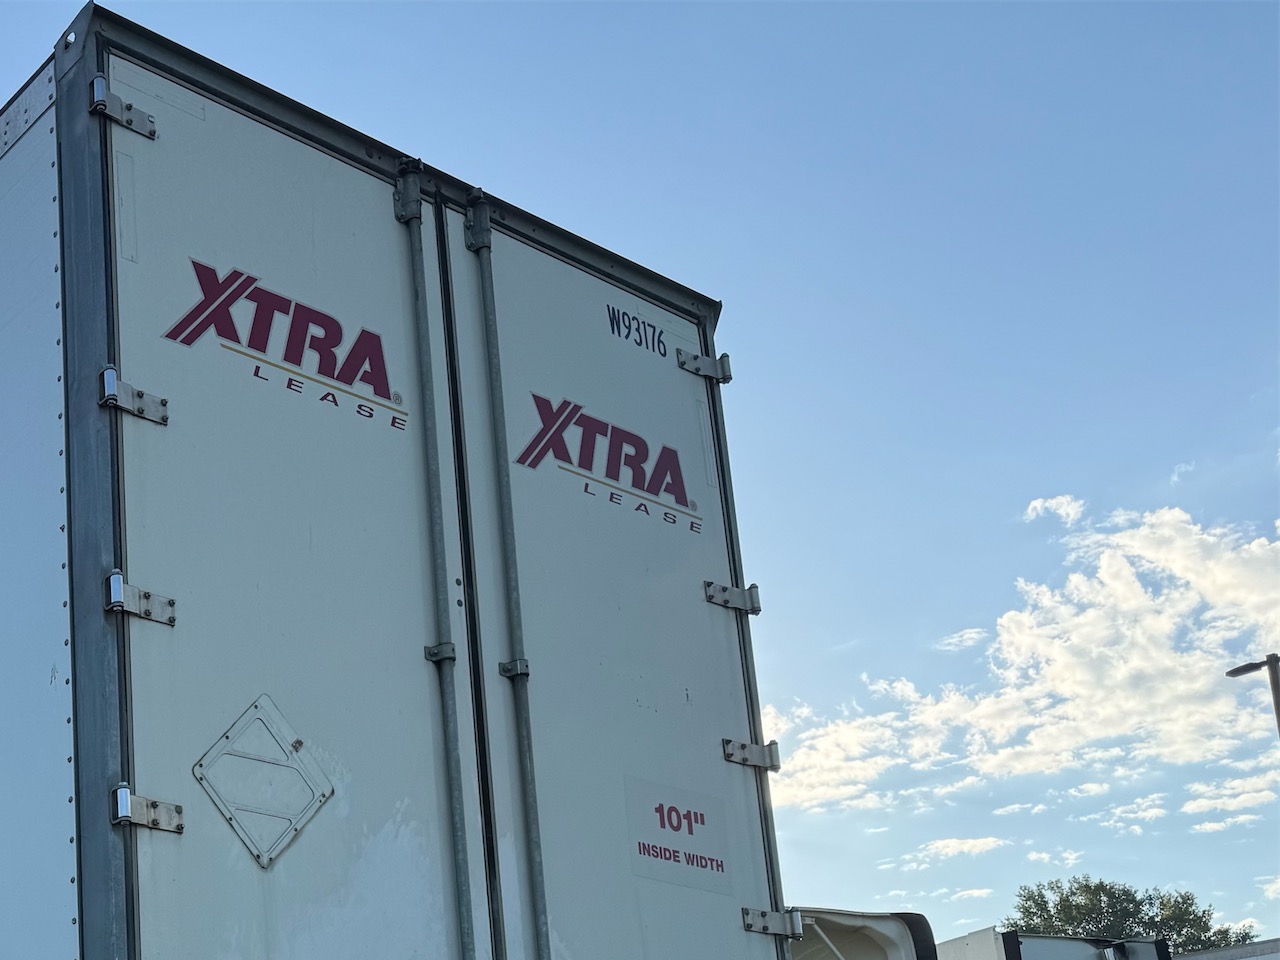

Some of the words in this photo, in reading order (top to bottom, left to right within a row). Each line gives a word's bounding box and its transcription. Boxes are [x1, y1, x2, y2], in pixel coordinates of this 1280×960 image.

[163, 259, 392, 401] XTRA
[607, 304, 667, 358] W93176
[254, 365, 408, 431] LEASE
[516, 392, 689, 508] XTRA
[583, 482, 702, 534] LEASE
[654, 803, 705, 835] 101"
[637, 841, 681, 863] INSIDE
[684, 852, 724, 873] WIDTH
